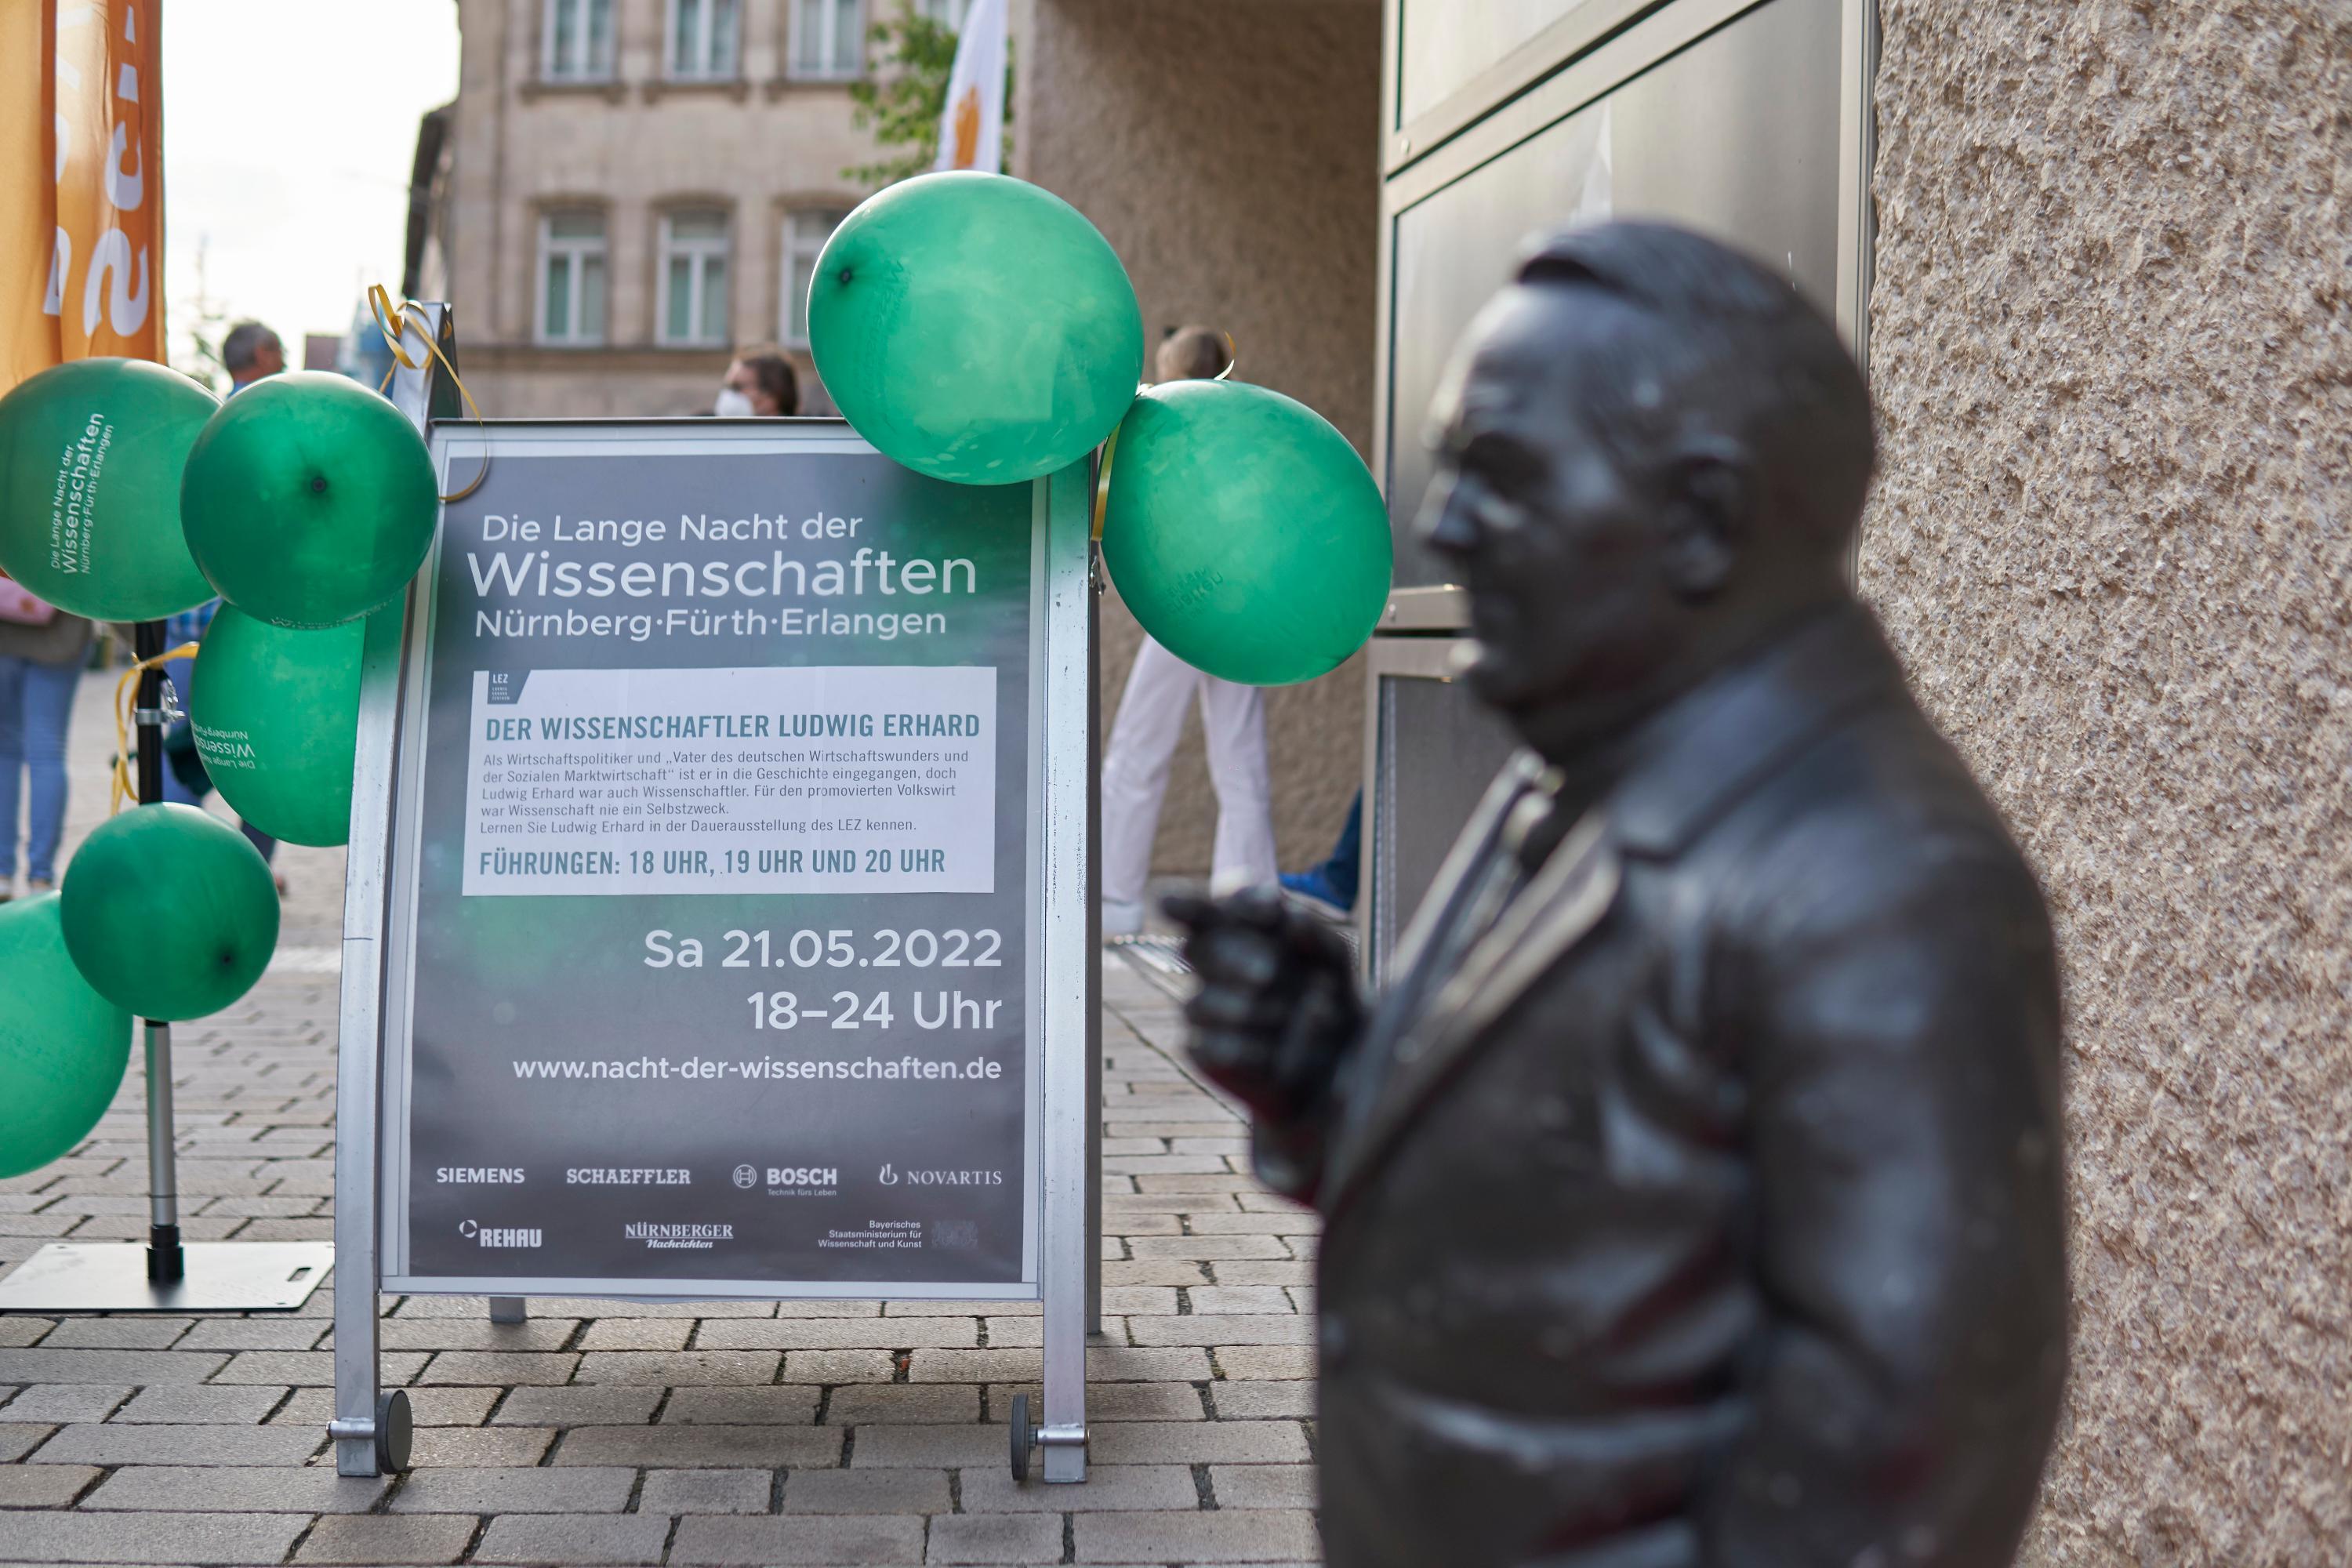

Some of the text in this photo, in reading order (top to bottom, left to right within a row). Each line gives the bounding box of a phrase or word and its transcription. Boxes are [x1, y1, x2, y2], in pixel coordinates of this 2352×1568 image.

[62, 413, 104, 574] Wissenschaften
[51, 445, 74, 569] Die Lange Nacht der
[482, 511, 862, 547] Die Lange Nacht der
[467, 547, 977, 597] Wissenschaften
[475, 607, 947, 642] Nürnberg·Fürth·Erlangen
[492, 673, 508, 684] LEZ
[486, 714, 979, 740] DER WISSENSCHAFTLER LUDWIG ERHARD
[484, 750, 968, 767] Als Wirtschaftspolitiker und „Vater des deutschen Wirtschaftswunders und
[484, 767, 956, 782] der Sozialen Marktwirtschaft“ ist er in die Geschichte eingegangen, doch
[482, 784, 956, 800] Ludwig Erhard war auch Wissenschaftler. Für den promovierten Volkswirt
[481, 803, 728, 816] war Wissenschaft nie ein Selbstzweck.
[481, 818, 916, 834] Lernen Sie Ludwig Erhard in der Dauerausstellung des LEZ kennen.
[480, 847, 945, 877] FÜHRUNGEN: 18 UHR, 19 UHR UND 20 UHR
[644, 929, 1002, 967] Sa 21.05.2022
[747, 991, 1002, 1029] 18–24 Uhr
[514, 1055, 1002, 1080] www.nacht-der-wissenschaften.de
[437, 1167, 524, 1183] SIEMENS
[566, 1169, 691, 1185] SCHAEFFLER
[767, 1168, 837, 1185] BOSCH
[908, 1171, 1002, 1185] NOVARTIS
[625, 1221, 734, 1238] NÜRNBERGER
[869, 1220, 920, 1230] Bayerisches
[480, 1229, 542, 1247] REHAU
[646, 1240, 713, 1248] Nachrichten
[818, 1240, 876, 1248] Wissenschaft
